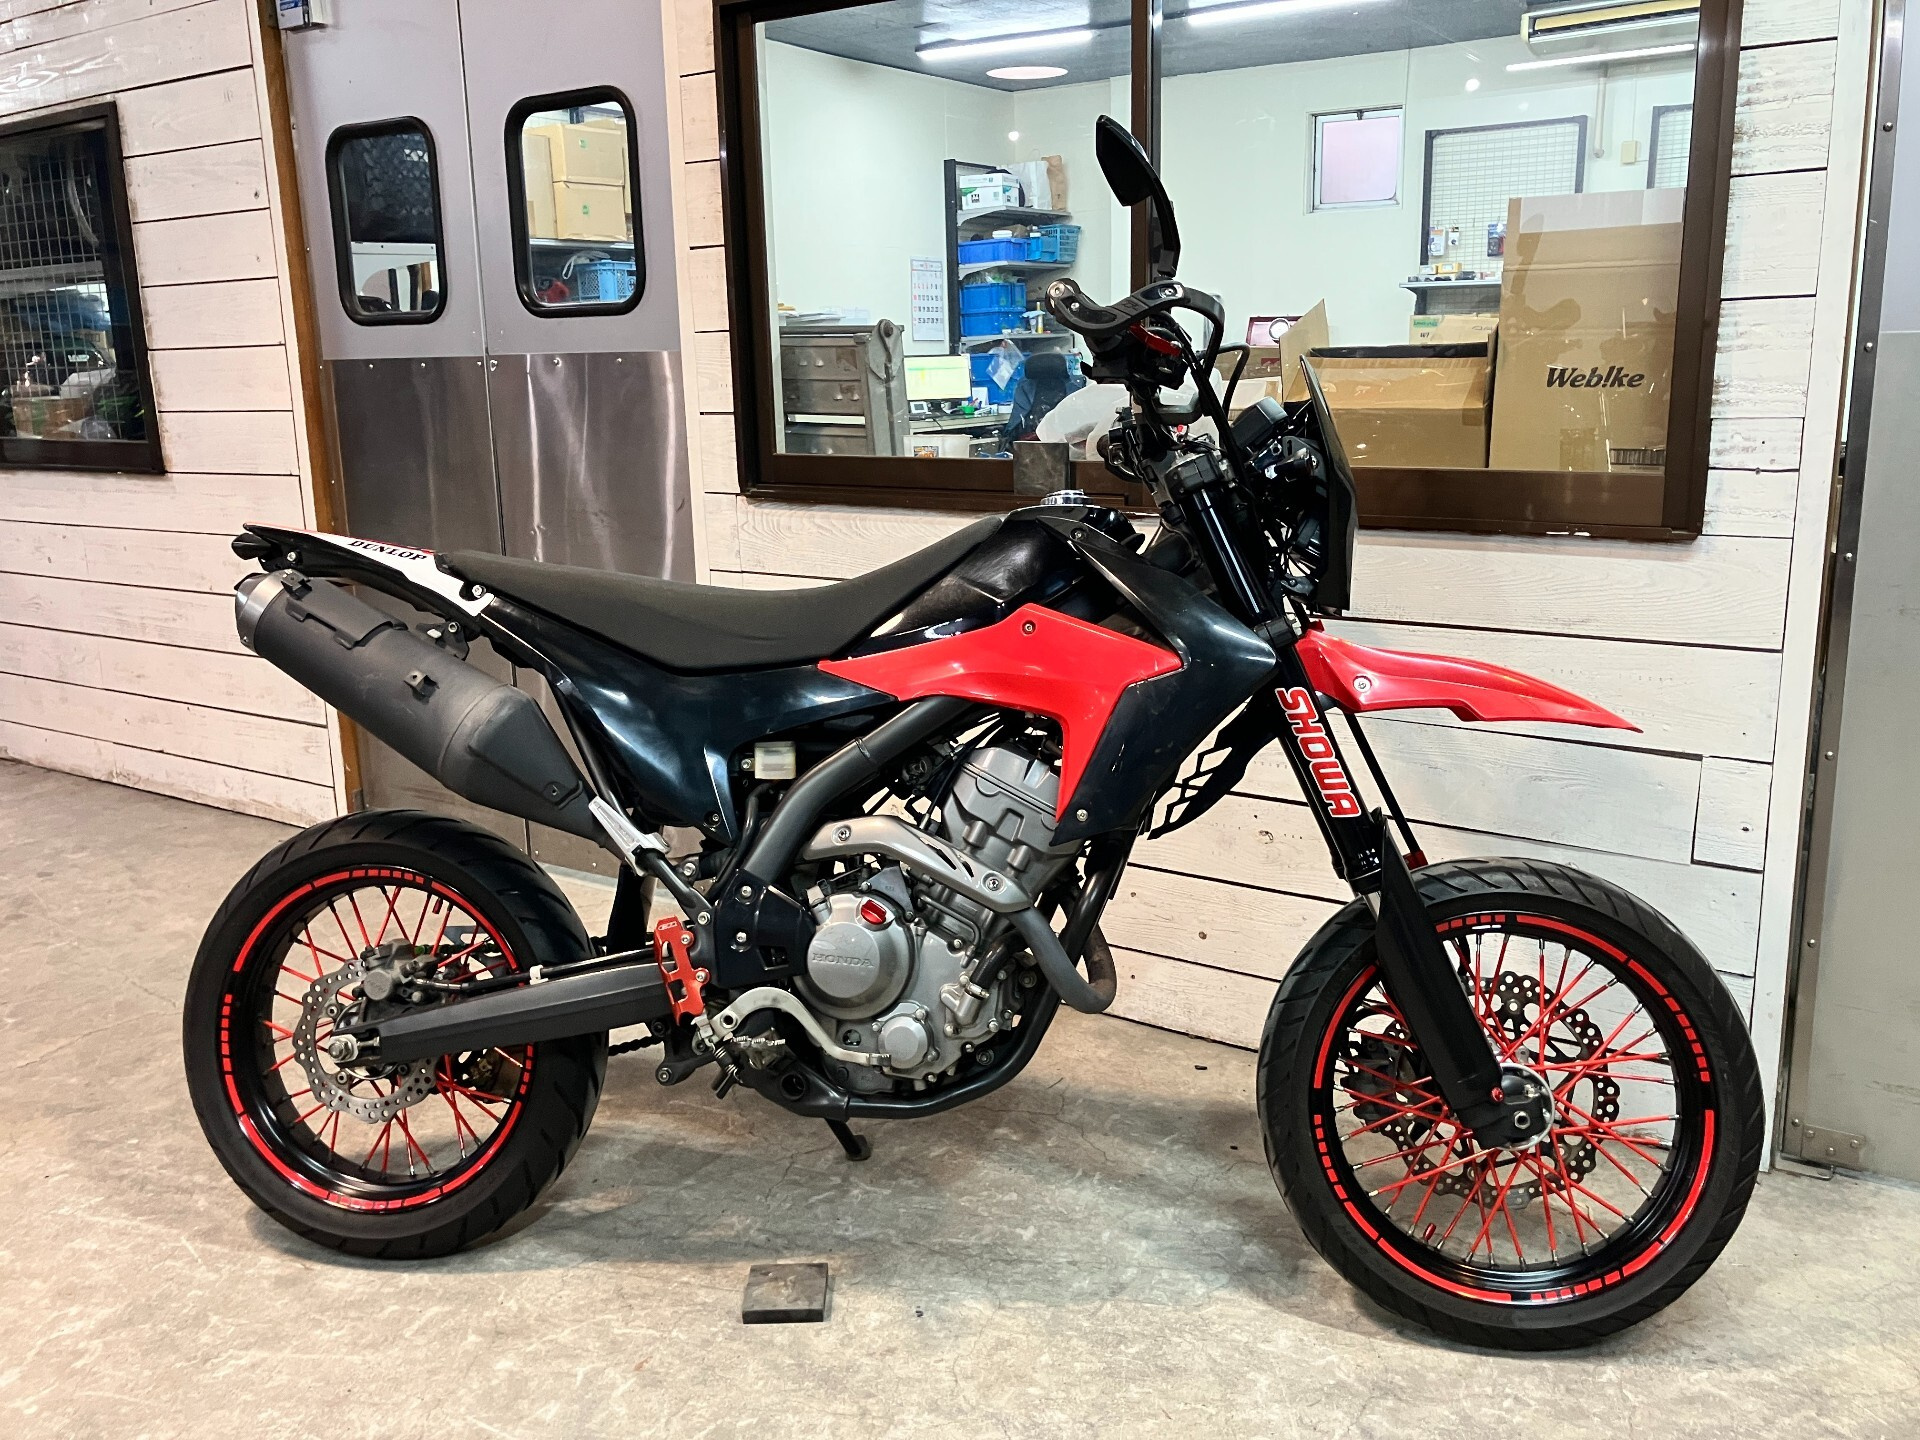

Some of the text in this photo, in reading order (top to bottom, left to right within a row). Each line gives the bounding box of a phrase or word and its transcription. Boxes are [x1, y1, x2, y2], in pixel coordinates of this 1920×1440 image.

[1546, 366, 1645, 388] Web!ke
[347, 540, 428, 560] DUNLOP
[1275, 686, 1361, 818] SHOWA
[812, 952, 874, 967] HONDA
